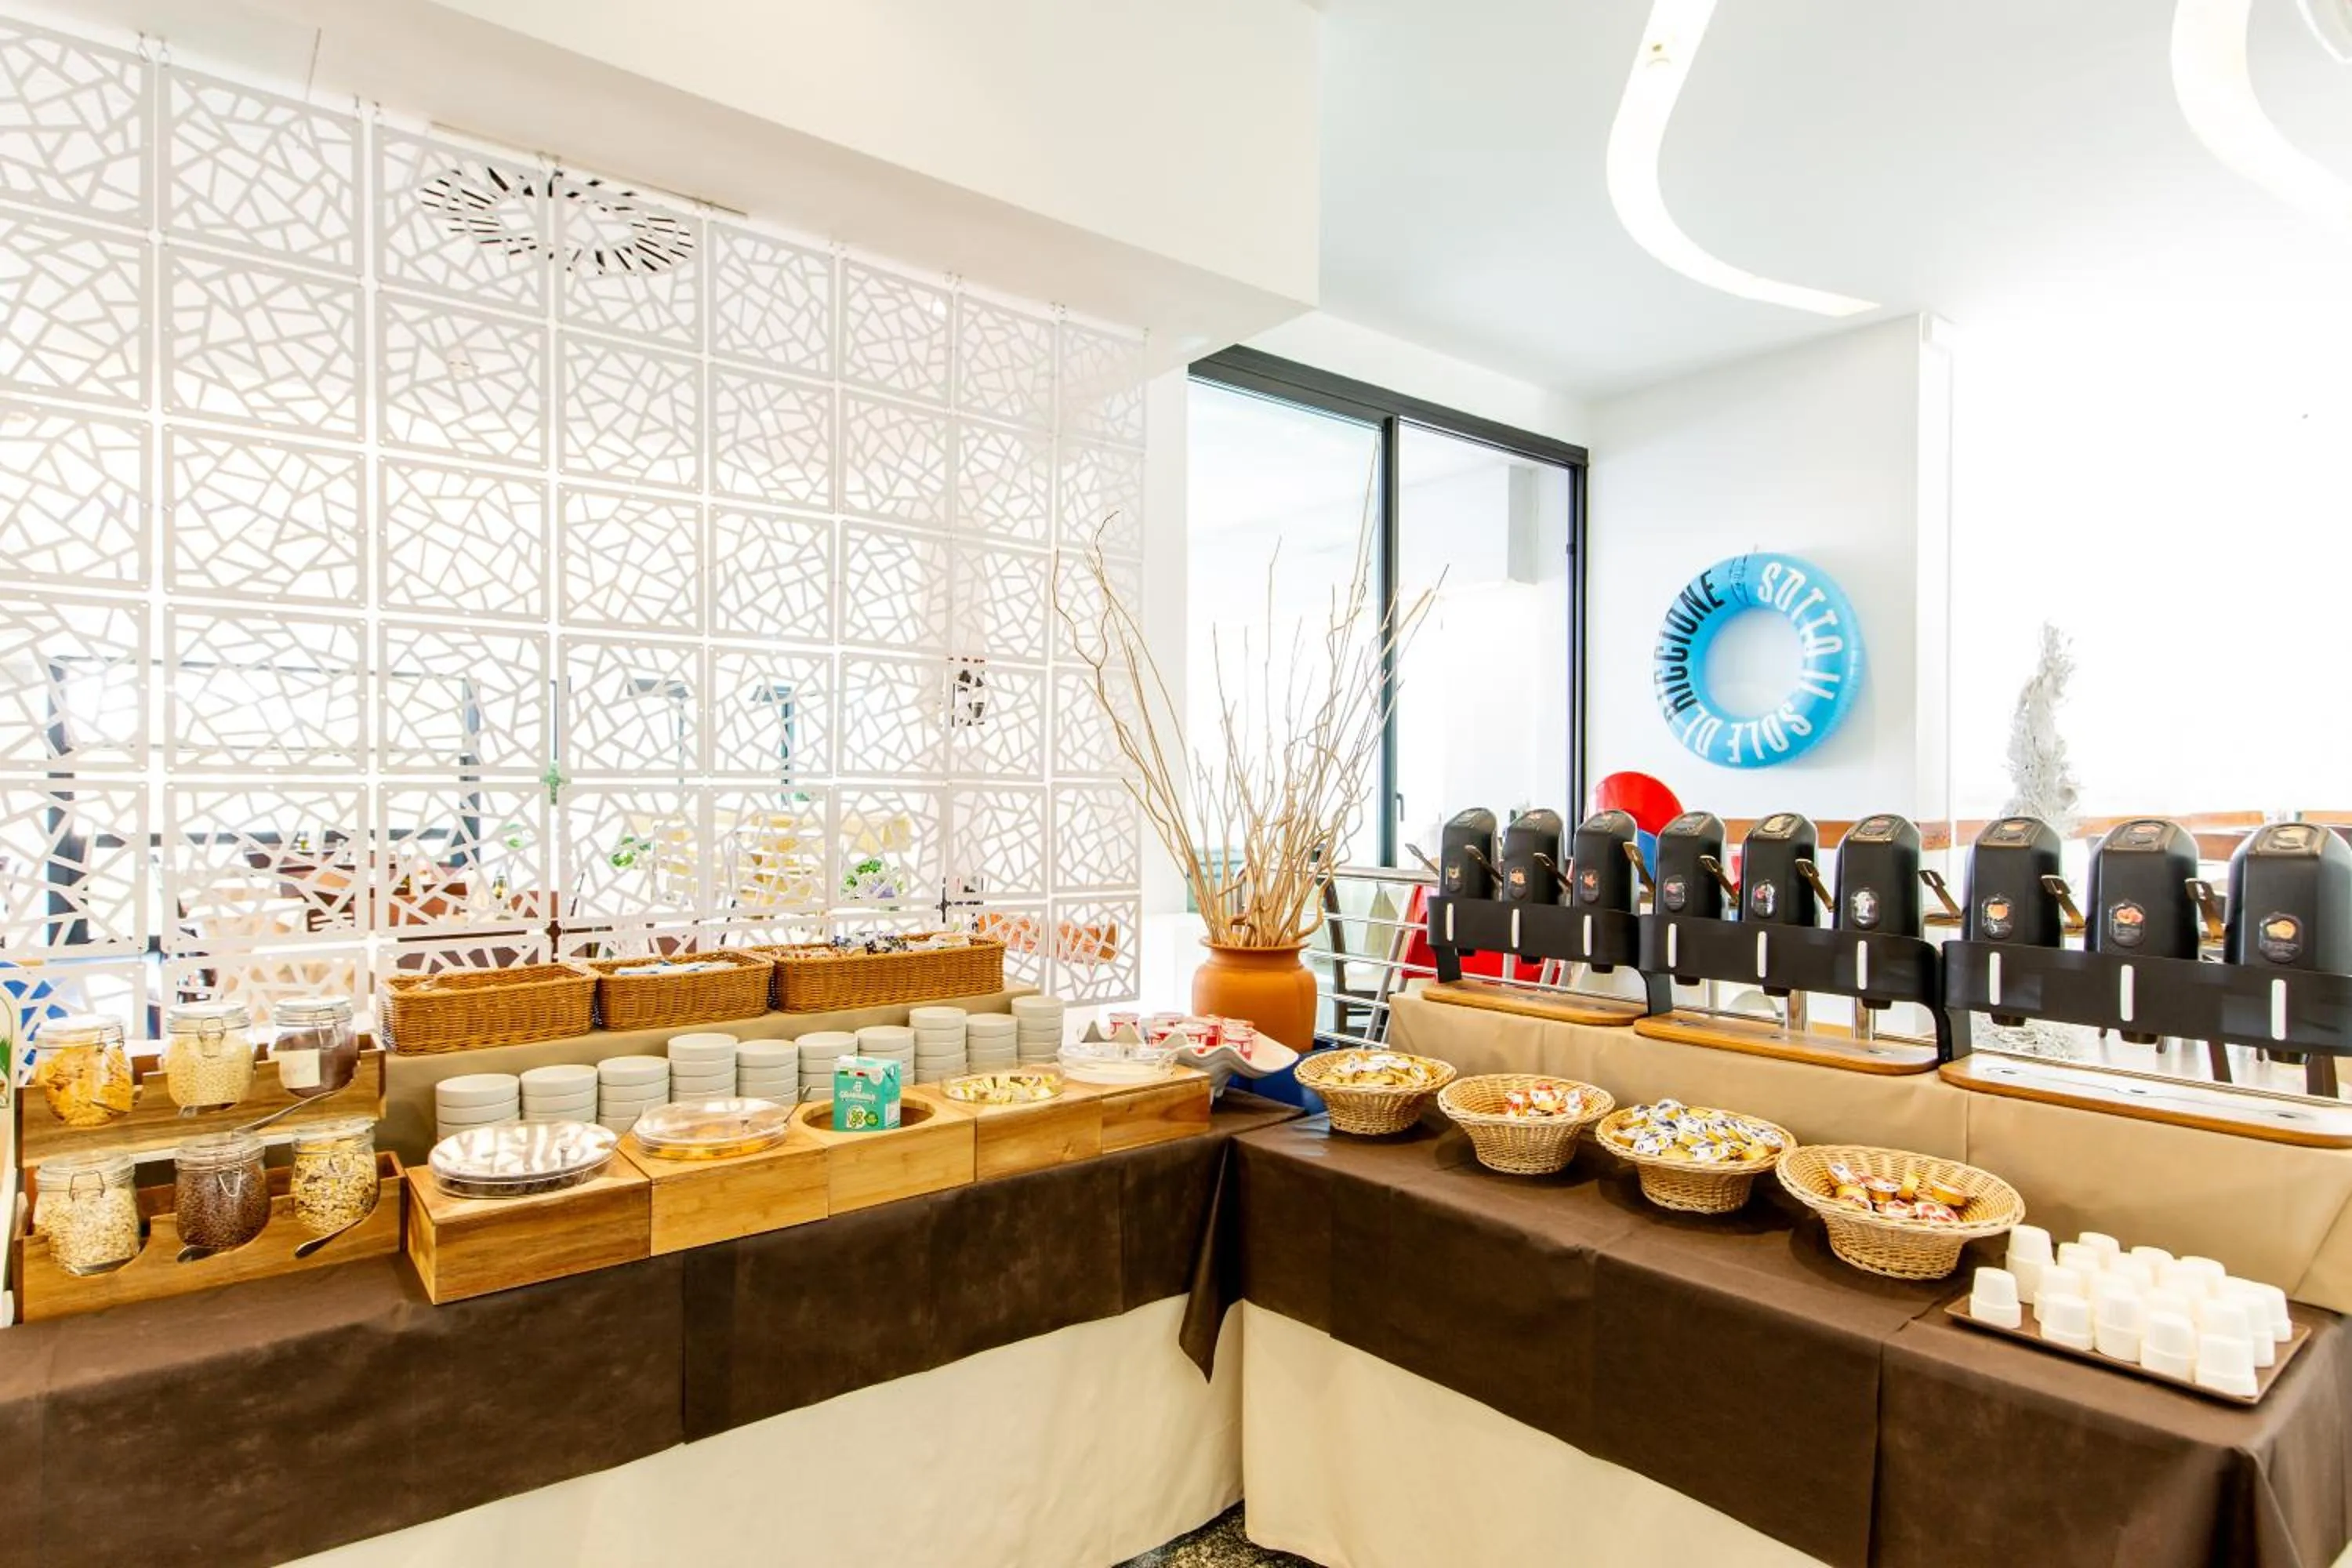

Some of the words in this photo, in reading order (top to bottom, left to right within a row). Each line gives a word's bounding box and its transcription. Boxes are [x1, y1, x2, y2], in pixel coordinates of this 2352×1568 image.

[1653, 568, 1726, 722] RICCIONE
[1757, 561, 1843, 659] SOTTO
[1727, 702, 1813, 763] SOLE
